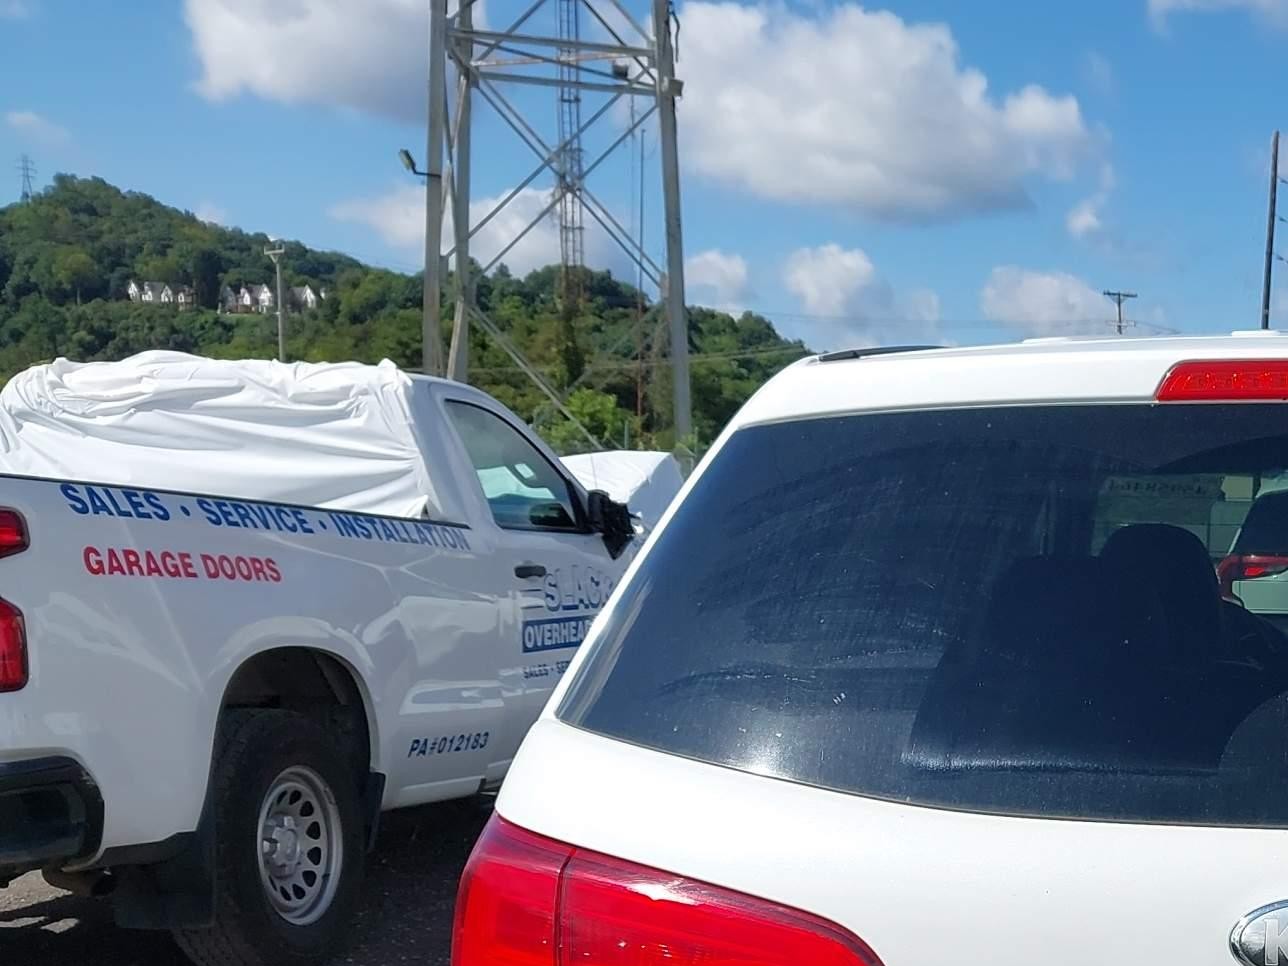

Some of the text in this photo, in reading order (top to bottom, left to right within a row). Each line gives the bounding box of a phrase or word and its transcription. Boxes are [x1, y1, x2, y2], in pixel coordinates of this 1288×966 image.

[60, 483, 472, 550] SALES SERVICE INSTALLATION
[83, 546, 282, 583] GARAGE DOORS
